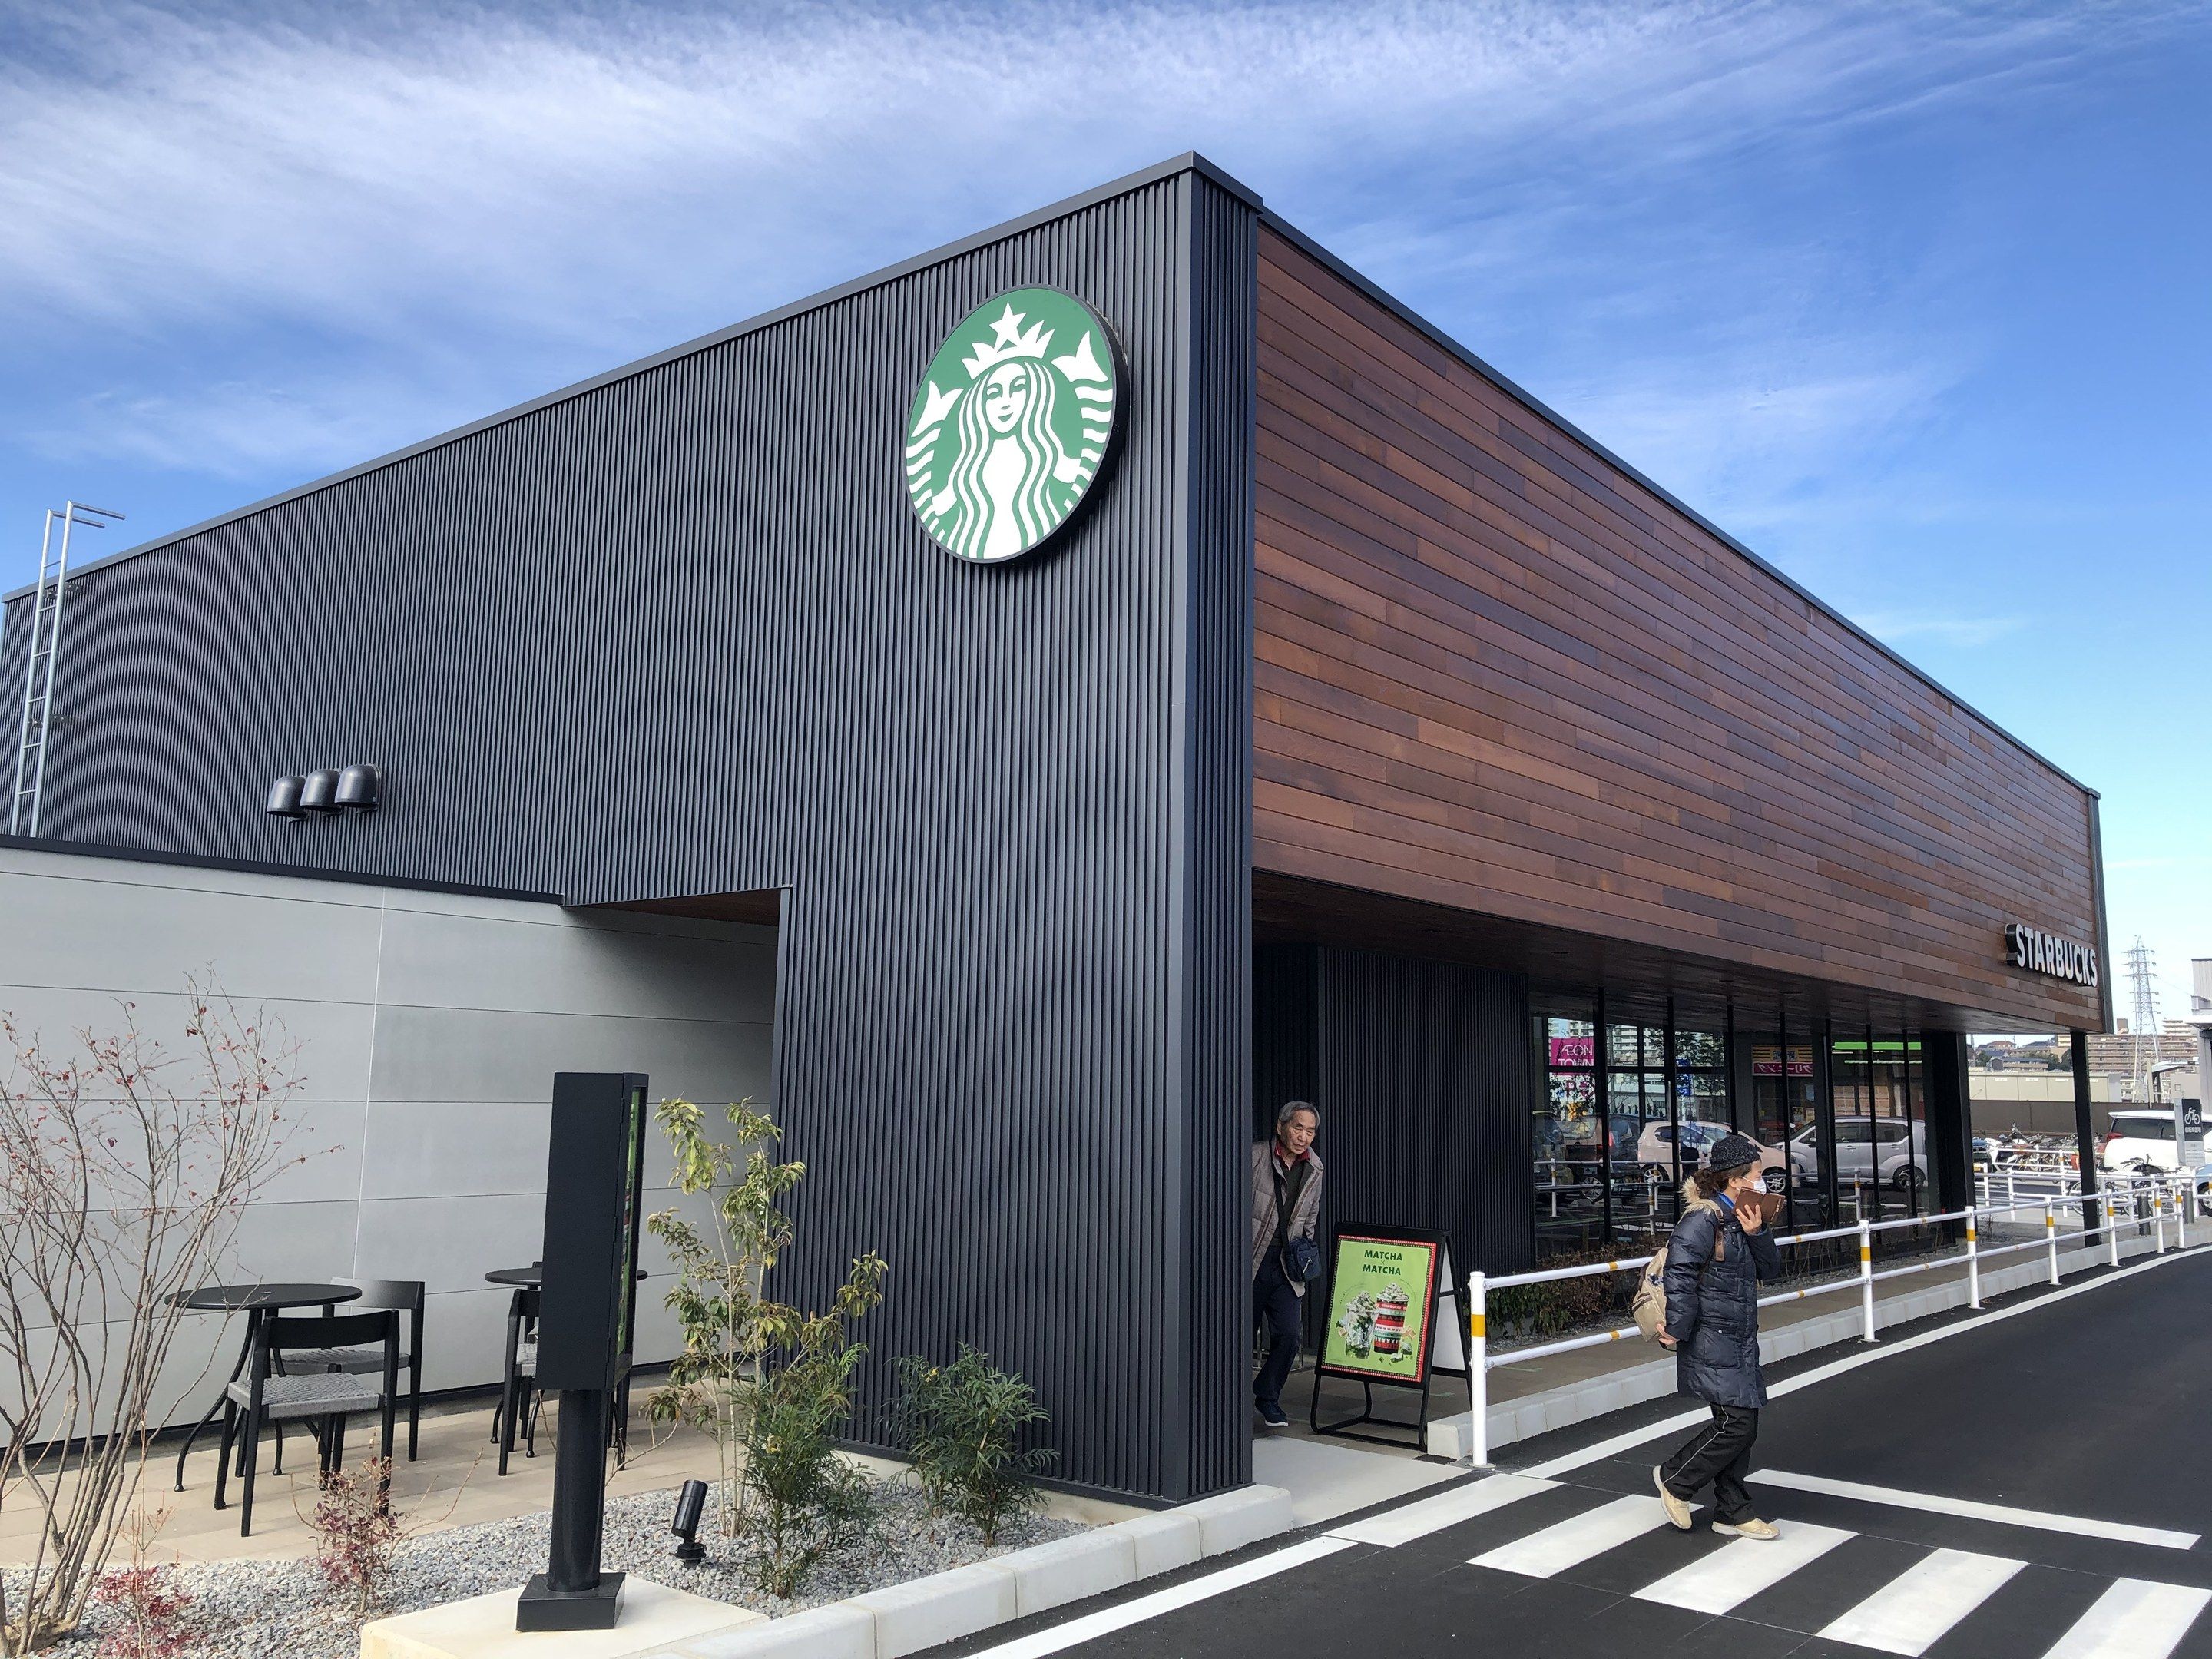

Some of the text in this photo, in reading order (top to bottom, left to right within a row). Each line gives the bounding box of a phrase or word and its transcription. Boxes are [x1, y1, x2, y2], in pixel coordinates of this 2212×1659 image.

[2015, 922, 2098, 987] STARBUCKS
[1364, 1250, 1402, 1261] MATCHA
[1363, 1264, 1401, 1275] MATCHA
